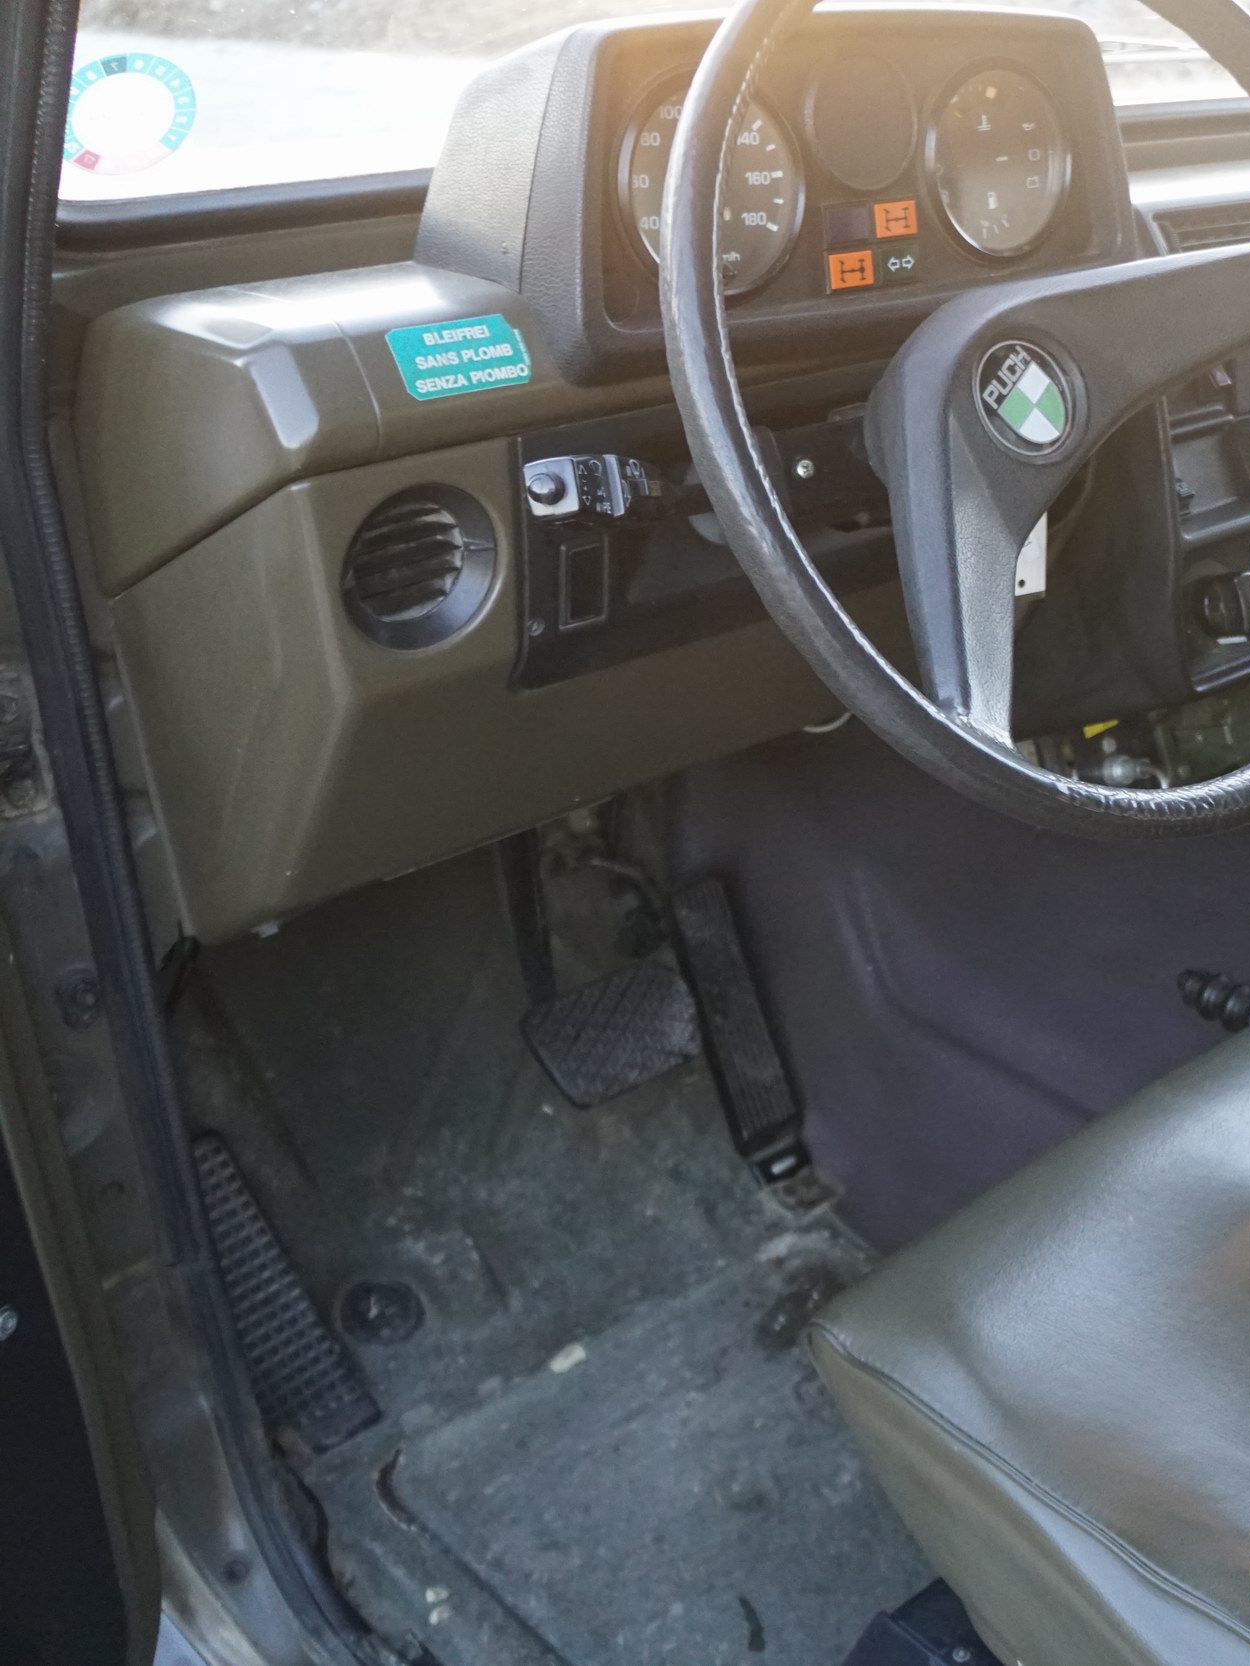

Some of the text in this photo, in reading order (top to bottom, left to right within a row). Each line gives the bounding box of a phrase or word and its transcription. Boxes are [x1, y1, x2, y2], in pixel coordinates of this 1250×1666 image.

[640, 132, 661, 147] 80
[745, 171, 771, 185] 160
[640, 216, 660, 230] 40
[741, 212, 767, 226] 180
[422, 324, 490, 346] BLEIFREI
[415, 351, 459, 370] SANS
[461, 343, 514, 363] PLOMB
[415, 363, 529, 394] SENZA PIOMBO
[982, 345, 1032, 410] PUCH
